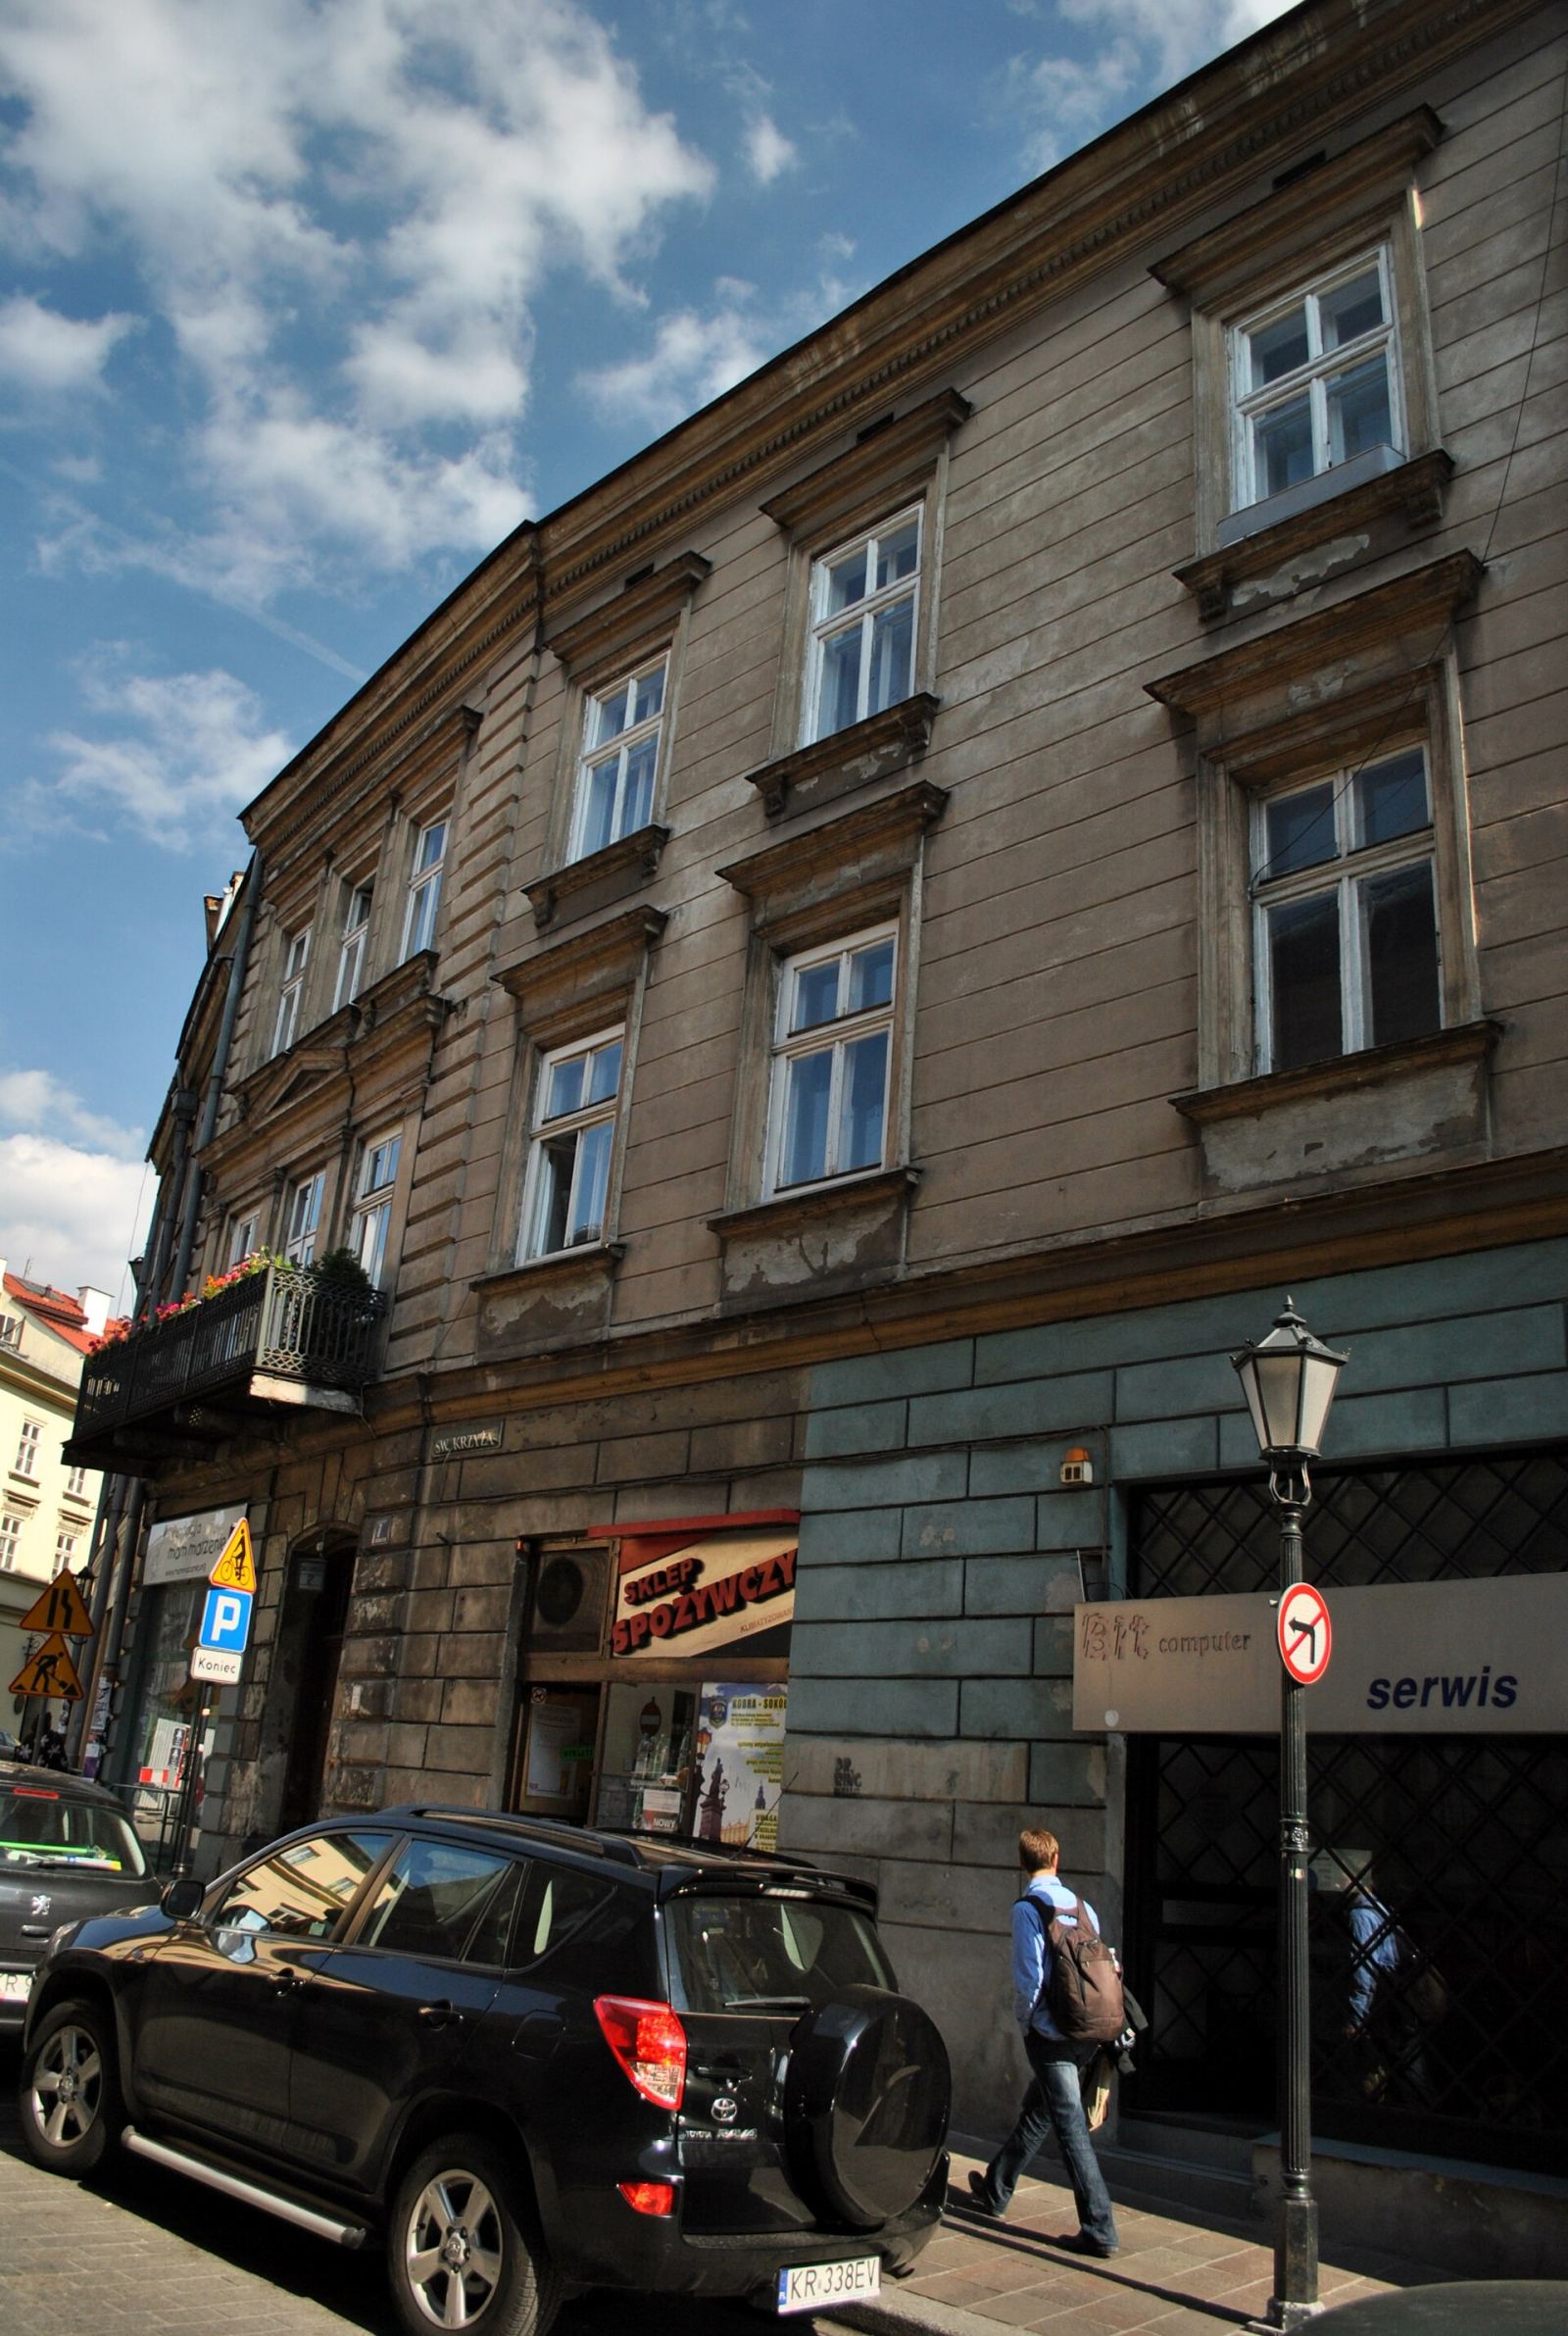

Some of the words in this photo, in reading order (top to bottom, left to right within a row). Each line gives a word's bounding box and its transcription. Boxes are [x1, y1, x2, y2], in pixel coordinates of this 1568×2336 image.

[612, 1549, 797, 1655] SPOŻYWCZY
[624, 1558, 700, 1604] SKLEP
[211, 1595, 241, 1641] P
[1159, 1630, 1251, 1657] computer
[198, 1658, 236, 1674] Koniec
[1366, 1665, 1518, 1710] serwis
[652, 1817, 676, 1828] NOWY
[791, 2268, 817, 2300] KR
[823, 2260, 876, 2295] 338EV
